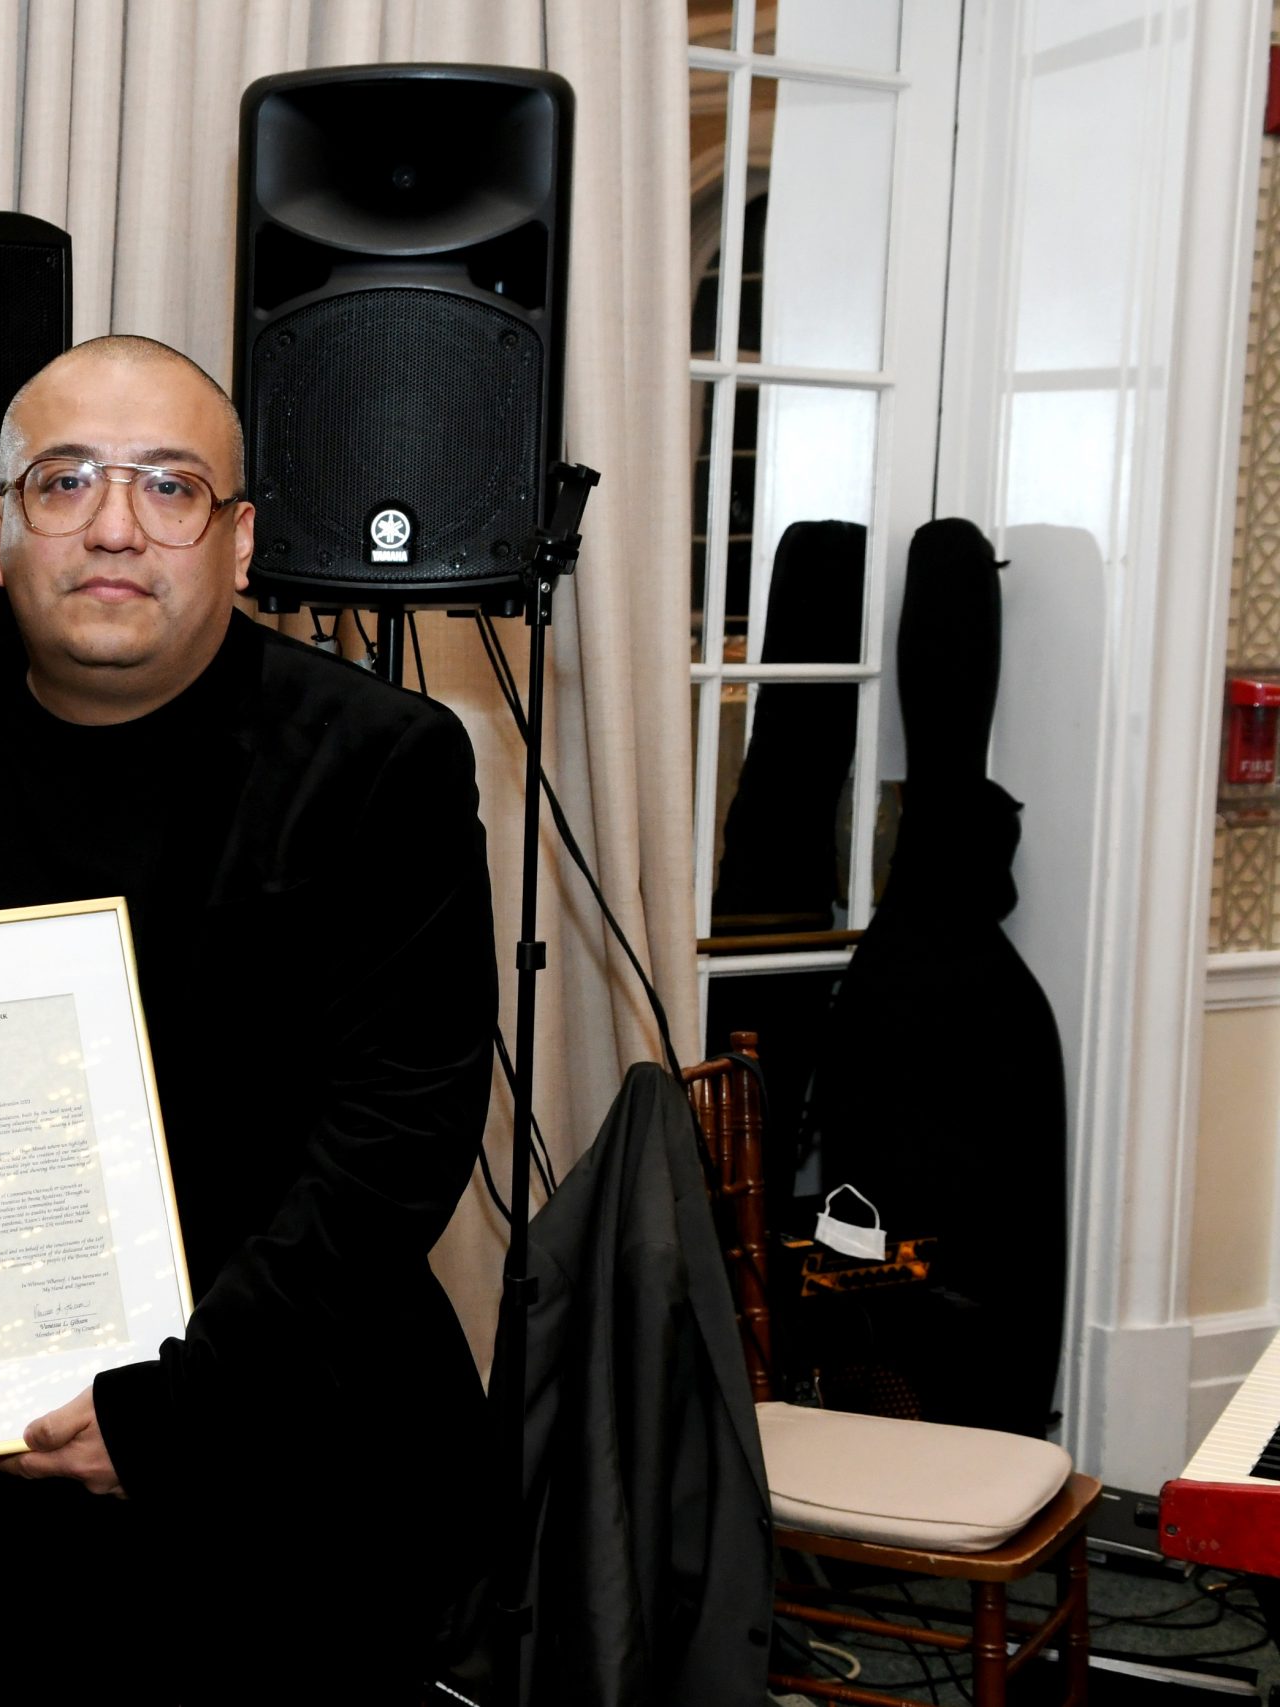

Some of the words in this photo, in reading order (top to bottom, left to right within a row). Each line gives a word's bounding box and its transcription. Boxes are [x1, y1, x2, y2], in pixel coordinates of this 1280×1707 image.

[1241, 760, 1273, 773] FIRE
[39, 1321, 62, 1330] Vanessa
[69, 1317, 89, 1326] Gibson
